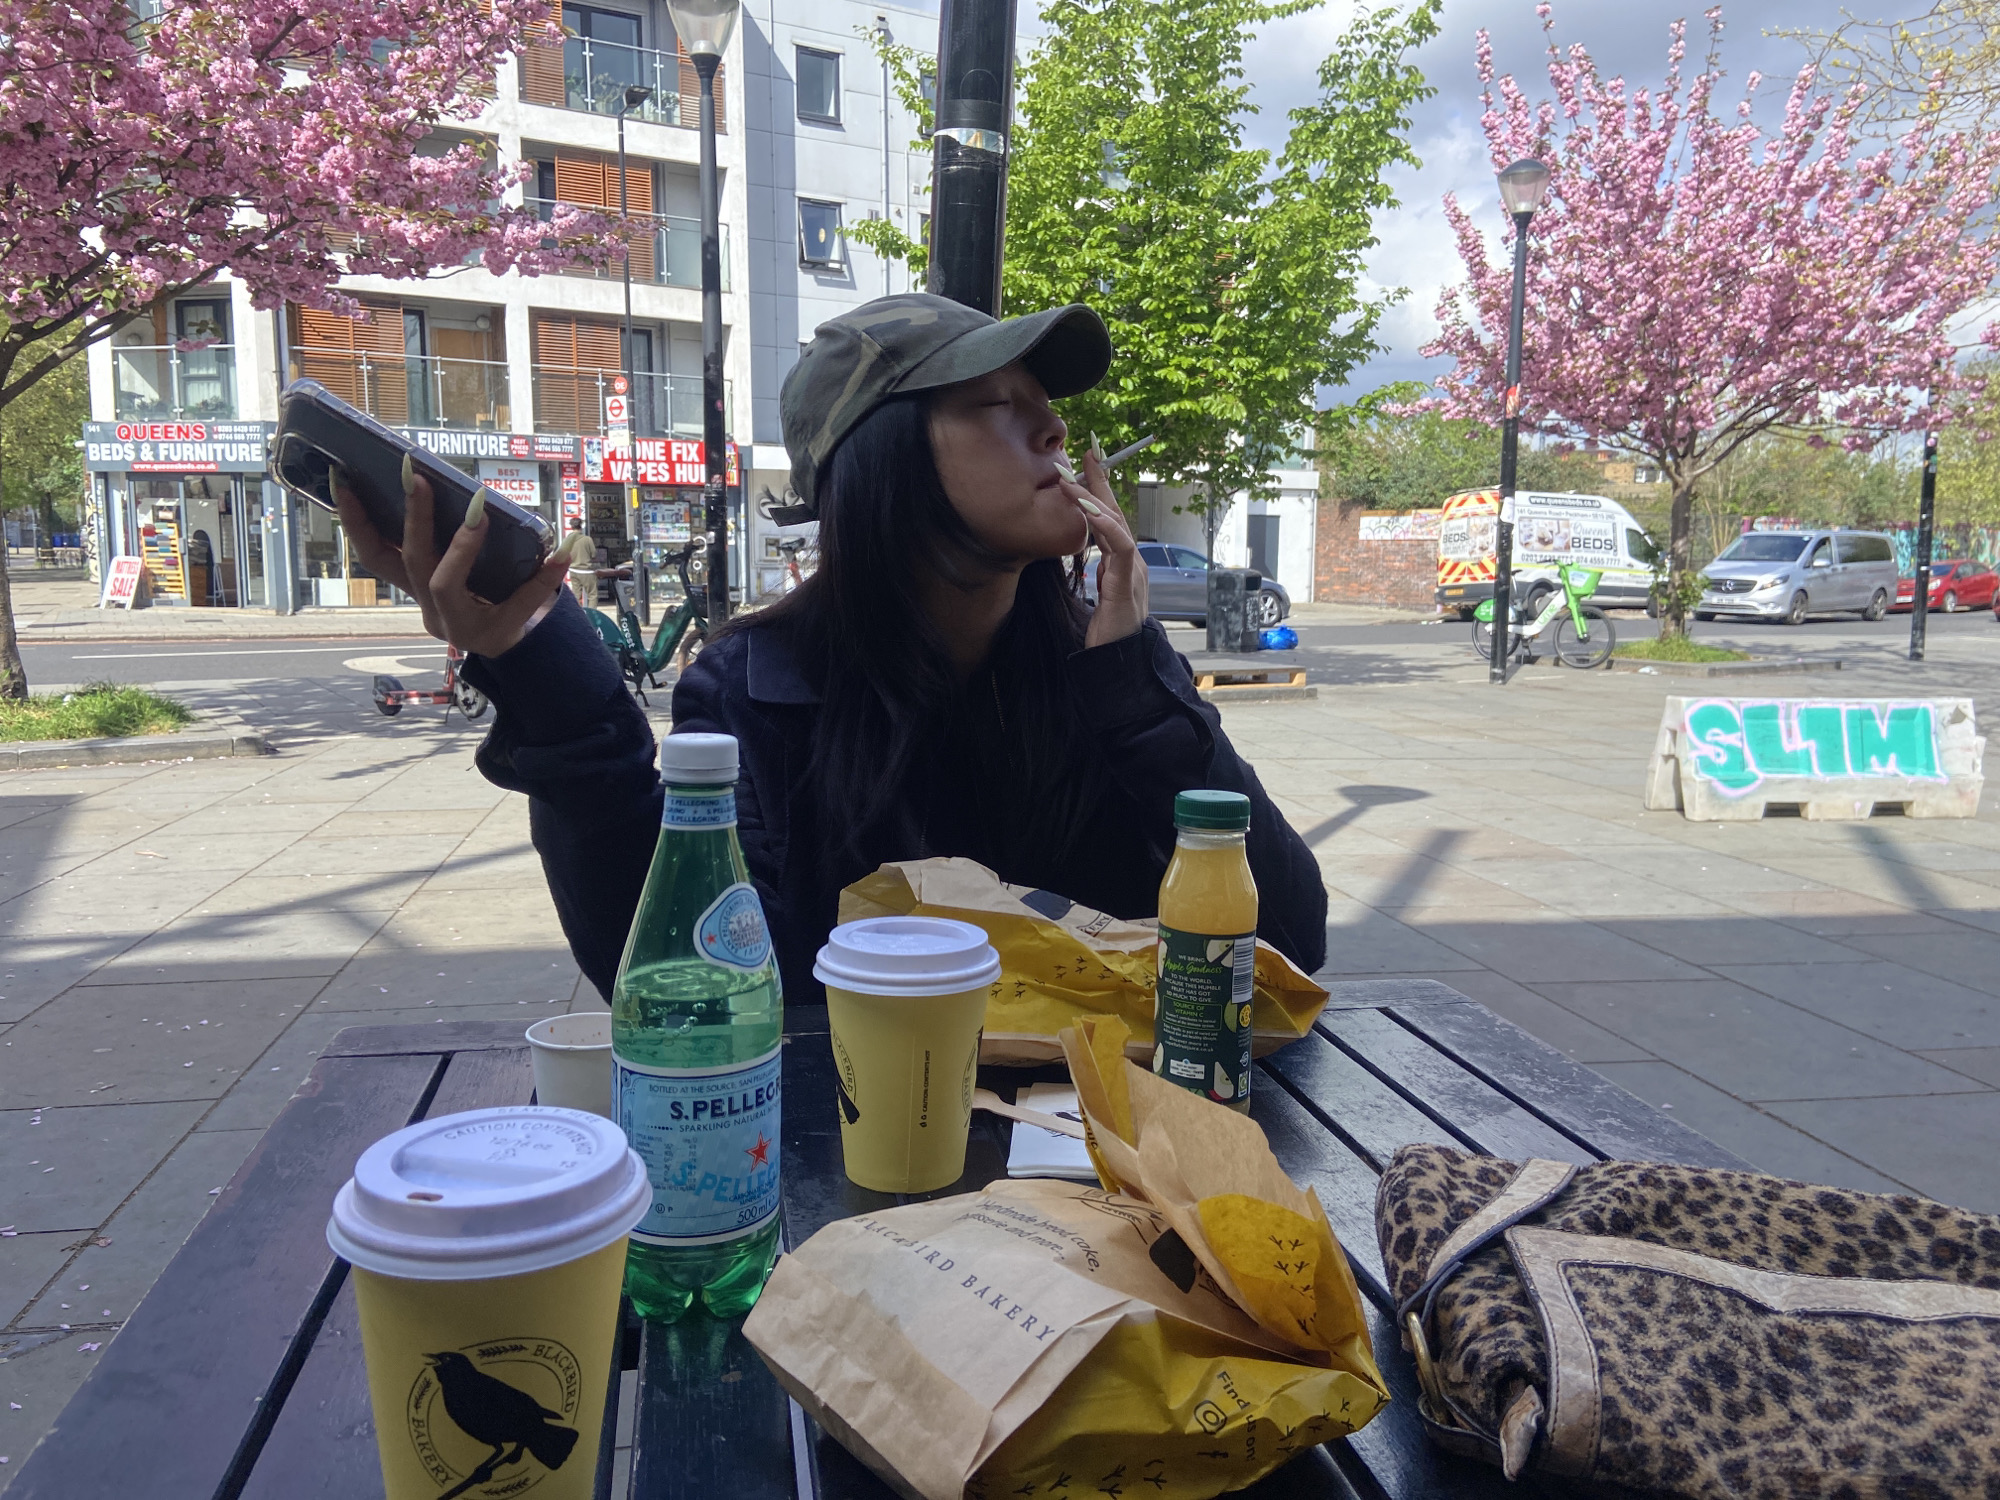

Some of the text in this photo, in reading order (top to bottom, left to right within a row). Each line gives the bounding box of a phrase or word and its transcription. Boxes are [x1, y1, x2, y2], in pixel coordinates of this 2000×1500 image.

[116, 423, 206, 442] QUEENS
[88, 443, 262, 462] BEDS & FURNITURE
[418, 432, 509, 456] FURNITURE
[603, 440, 700, 462] PHONE FIX
[610, 461, 670, 482] VAPES
[483, 478, 534, 491] PRICES
[1443, 532, 1466, 543] BEDS
[1572, 522, 1610, 536] Queens
[1572, 537, 1614, 550] BEDS
[1521, 553, 1537, 562] 0203
[110, 577, 135, 596] SALE
[620, 617, 635, 648] forest
[1165, 958, 1222, 974] Apple Goodness
[1164, 977, 1183, 987] BECAUSE
[1173, 1002, 1194, 1010] SOURCE
[1175, 1008, 1198, 1017] VITAMIN
[649, 1084, 678, 1094] BOTTLED
[680, 1120, 730, 1132] SPARKLING
[734, 1111, 766, 1125] NATURAL
[444, 1122, 516, 1140] CAUTION
[520, 1122, 586, 1143] CONTENTS
[976, 1200, 1037, 1224] Handmade
[1071, 1236, 1100, 1272] cake,
[1005, 1227, 1035, 1238] and
[854, 1217, 1055, 1341] BLACKBIRD BAKERY
[532, 1344, 577, 1413] BLACKBIRD
[1217, 1370, 1250, 1410] Find
[1245, 1415, 1256, 1434] us
[412, 1416, 454, 1486] BAKERY
